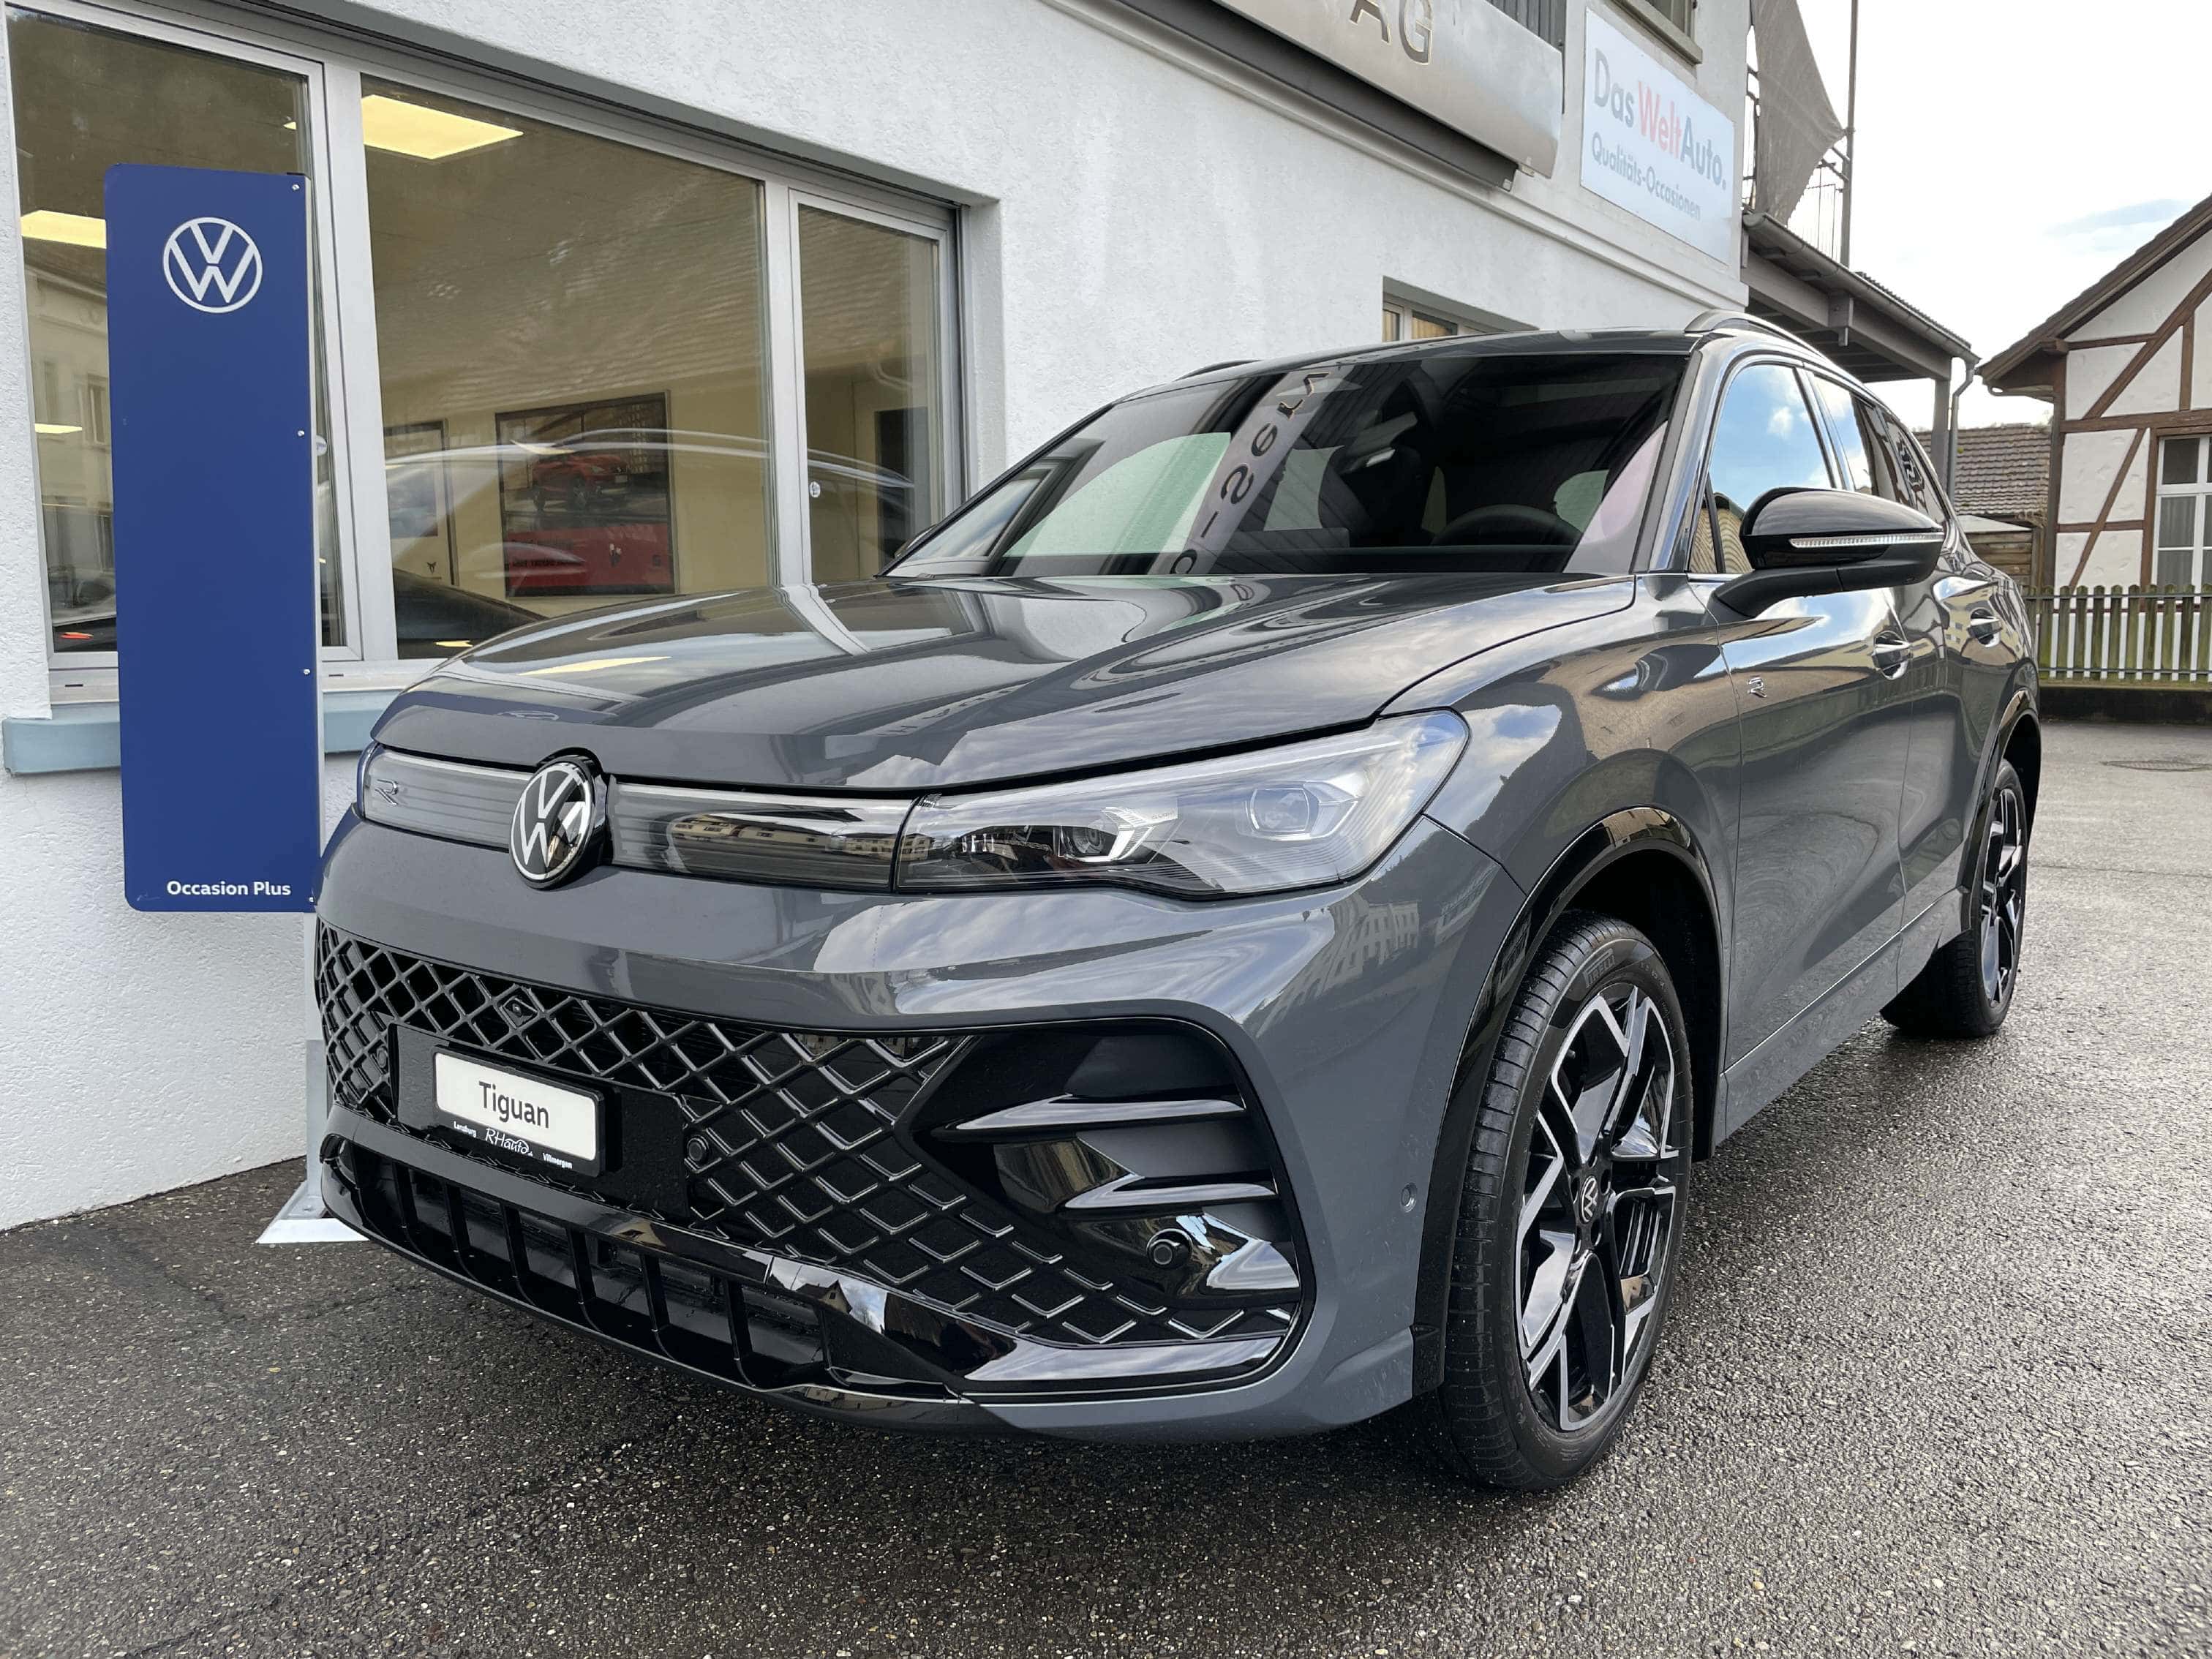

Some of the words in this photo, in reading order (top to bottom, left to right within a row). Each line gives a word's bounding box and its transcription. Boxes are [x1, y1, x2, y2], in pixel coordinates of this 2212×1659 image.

[1594, 48, 1635, 128] Das
[1592, 132, 1701, 221] Qualitäts-Occasionen
[168, 220, 257, 304] VW
[166, 881, 249, 895] Occasion
[253, 881, 292, 895] Plus
[478, 1080, 549, 1129] Tiguan
